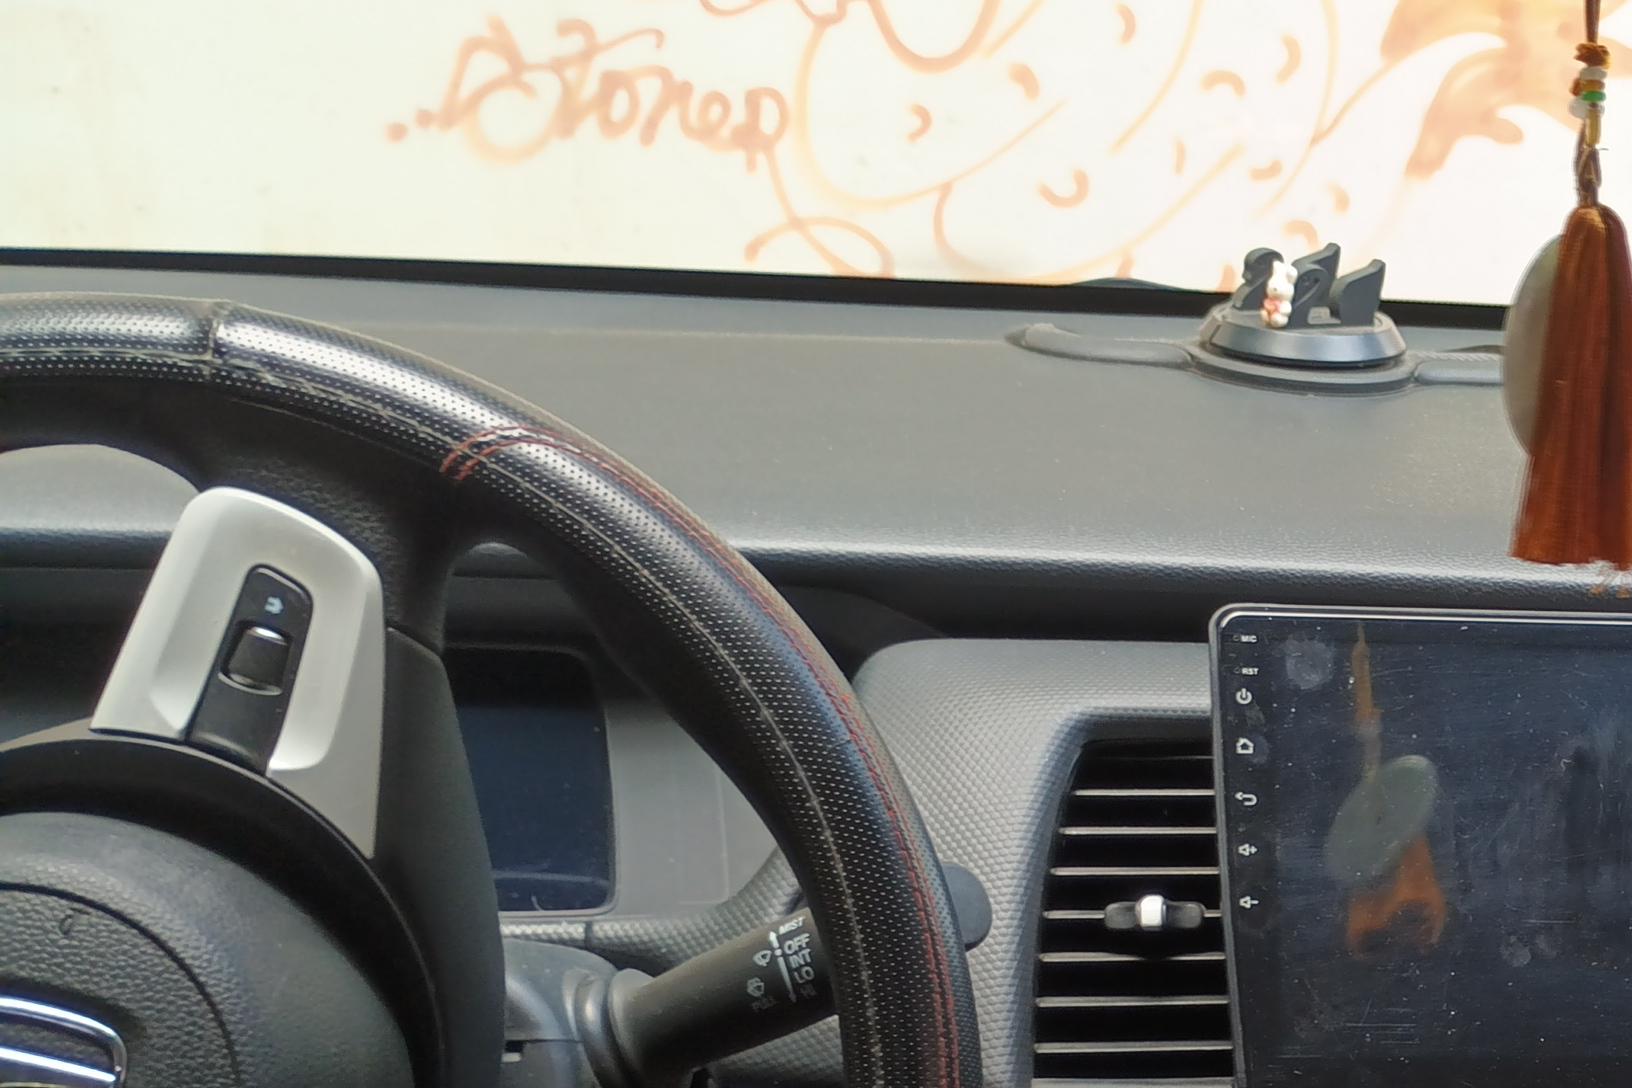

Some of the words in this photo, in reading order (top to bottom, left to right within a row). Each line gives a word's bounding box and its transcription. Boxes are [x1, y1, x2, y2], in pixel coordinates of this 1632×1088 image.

[1241, 634, 1257, 642] MIC
[1241, 667, 1259, 675] RST
[783, 933, 810, 954] OFF
[788, 948, 811, 968] INT
[794, 966, 814, 983] LO
